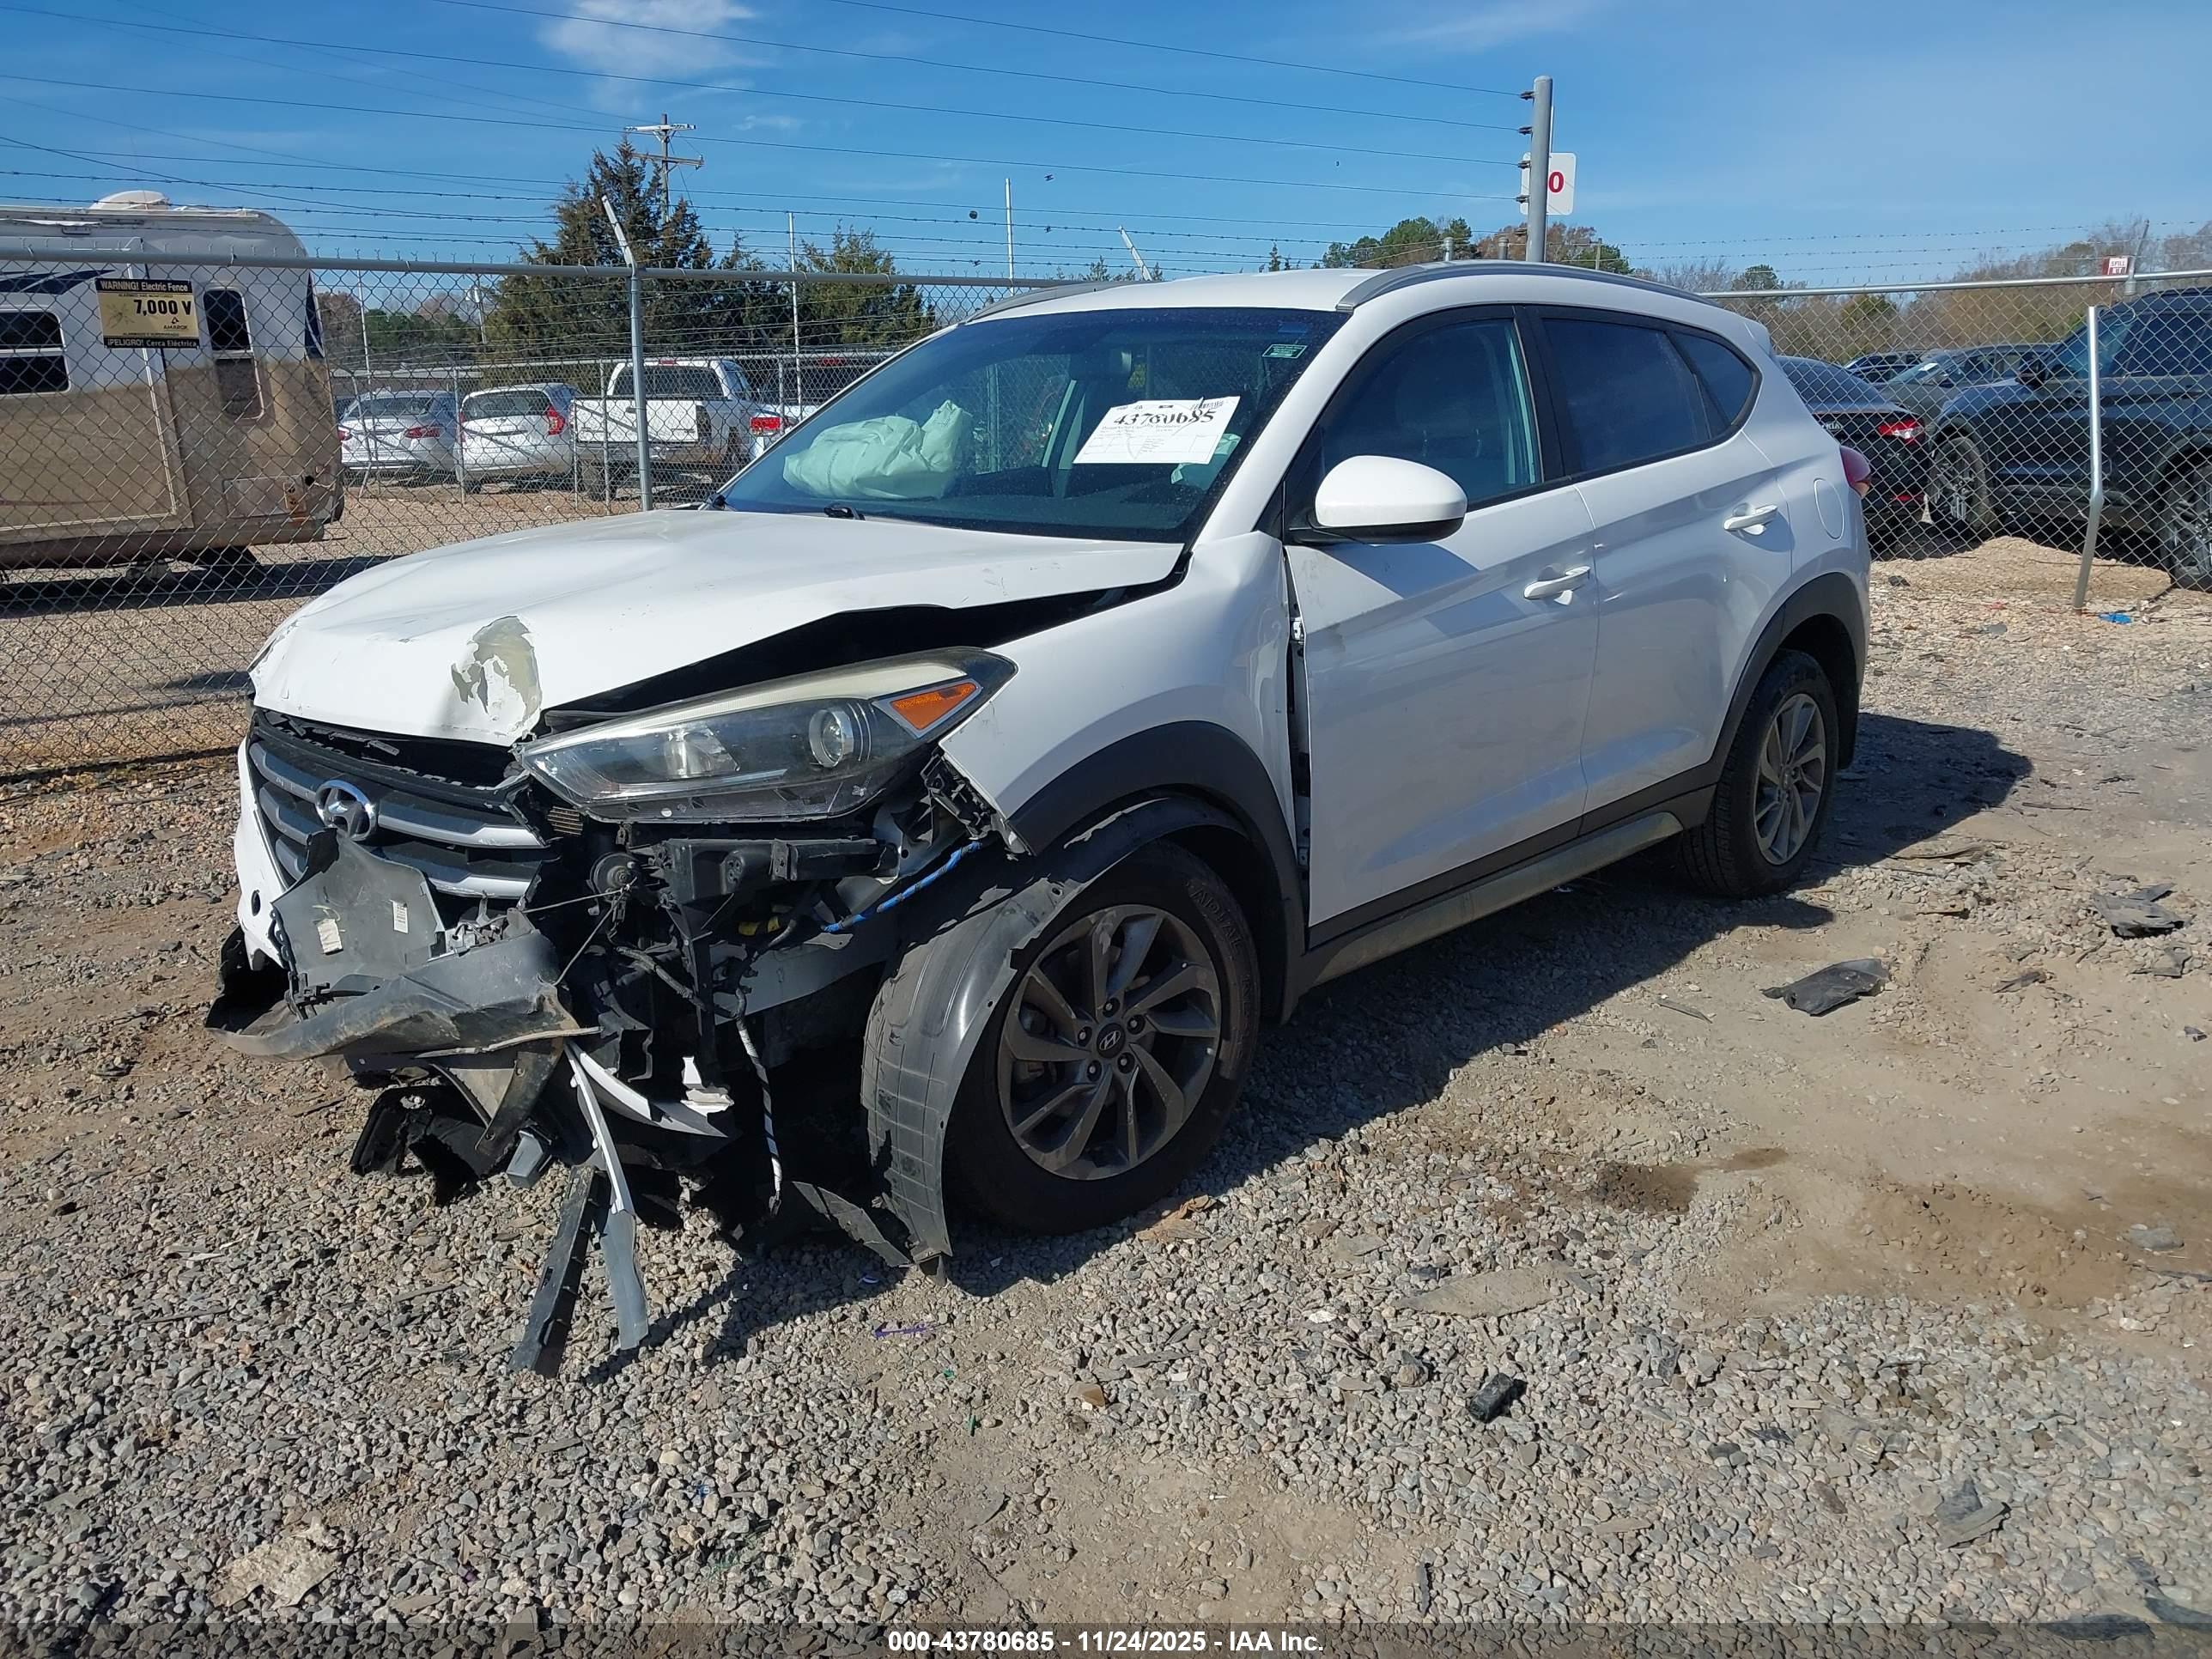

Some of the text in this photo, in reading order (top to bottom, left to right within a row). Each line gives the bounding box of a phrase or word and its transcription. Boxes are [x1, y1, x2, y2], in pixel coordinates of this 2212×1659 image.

[1549, 172, 1564, 192] 0
[100, 281, 188, 292] WARNING! Electric Fence
[134, 300, 191, 316] 7,000 V
